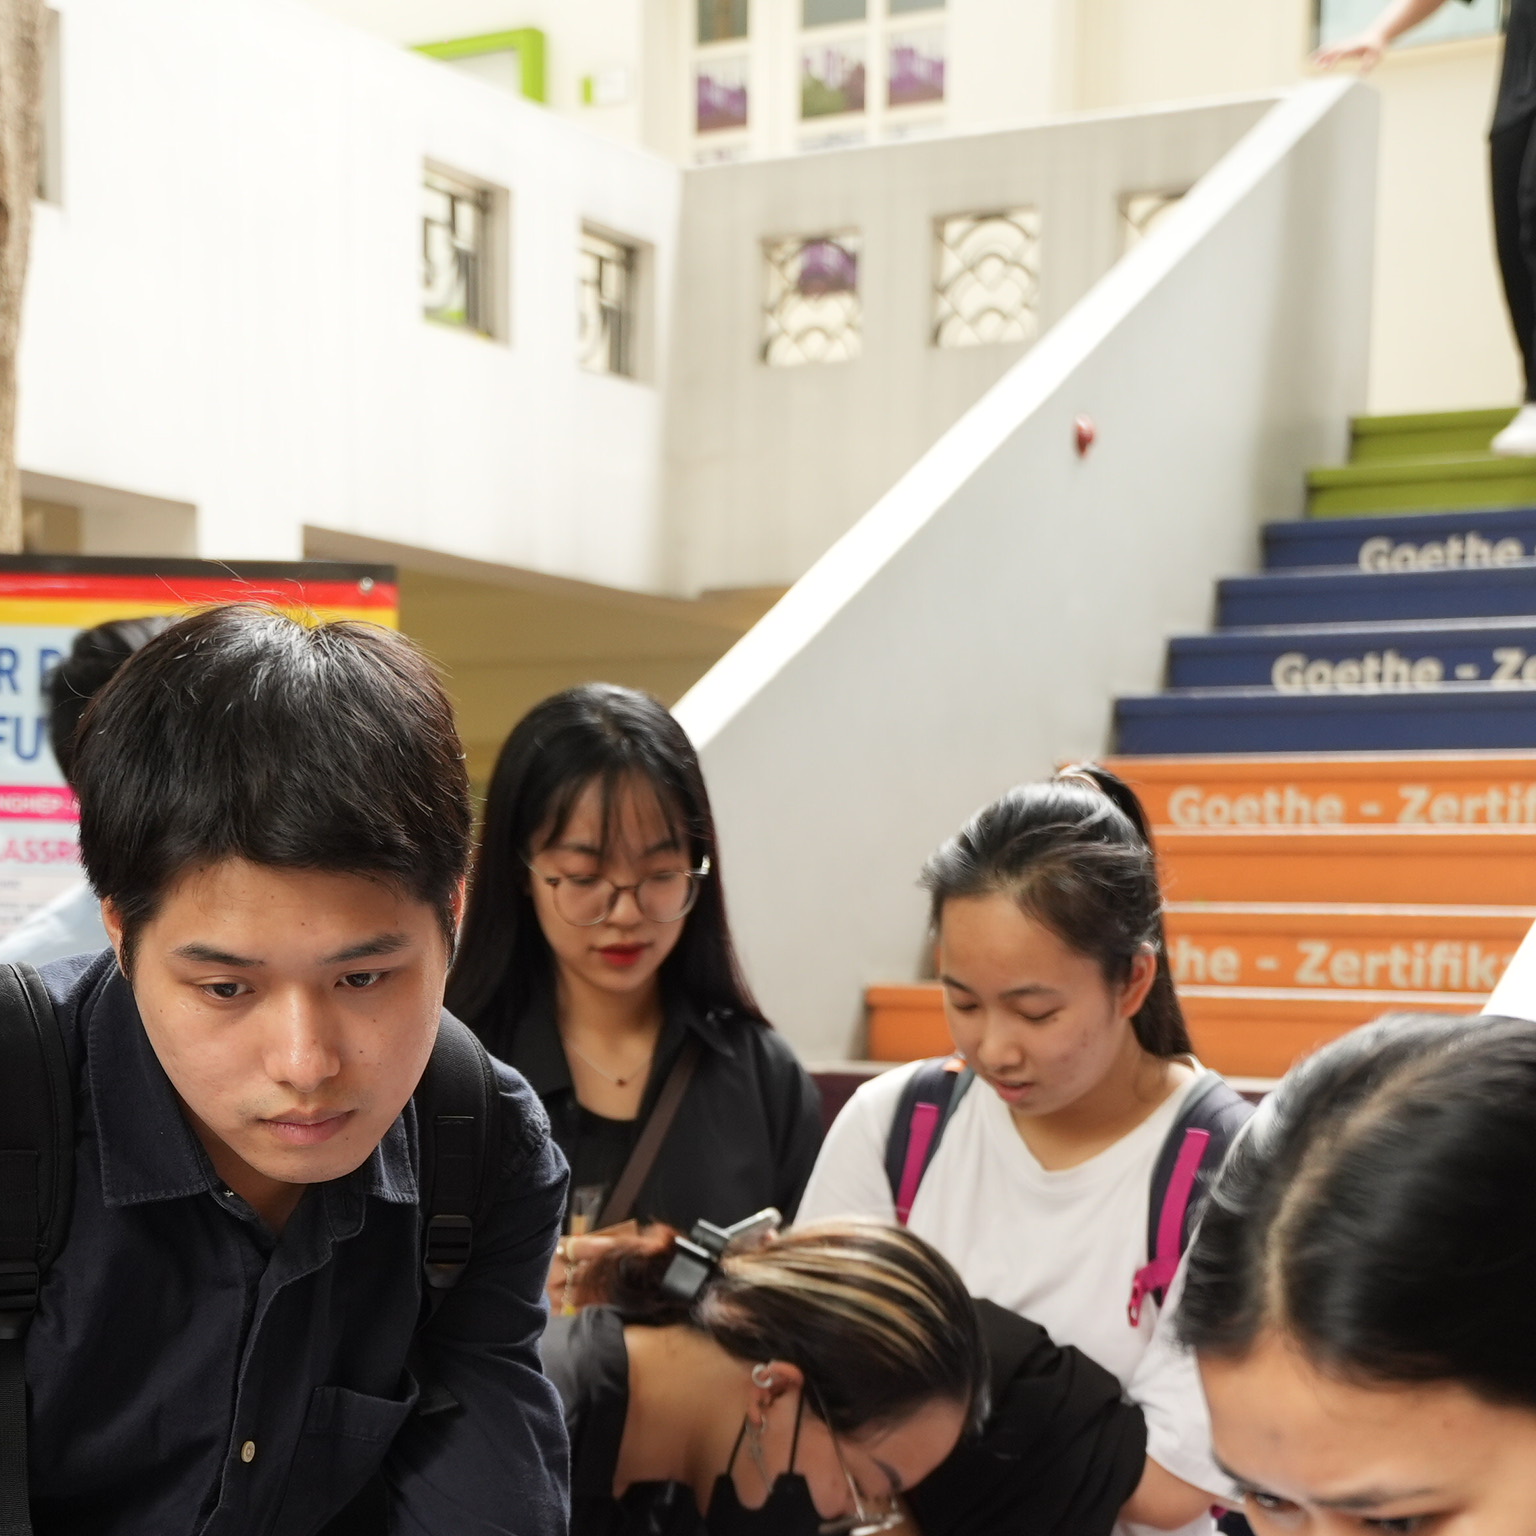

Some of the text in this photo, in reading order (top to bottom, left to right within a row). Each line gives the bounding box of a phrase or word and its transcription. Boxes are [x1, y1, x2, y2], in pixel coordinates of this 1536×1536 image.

[1357, 531, 1525, 572] Goethe
[1271, 650, 1444, 694] Goethe
[1167, 786, 1345, 828] Goethe
[1295, 940, 1510, 988] Zertifik
